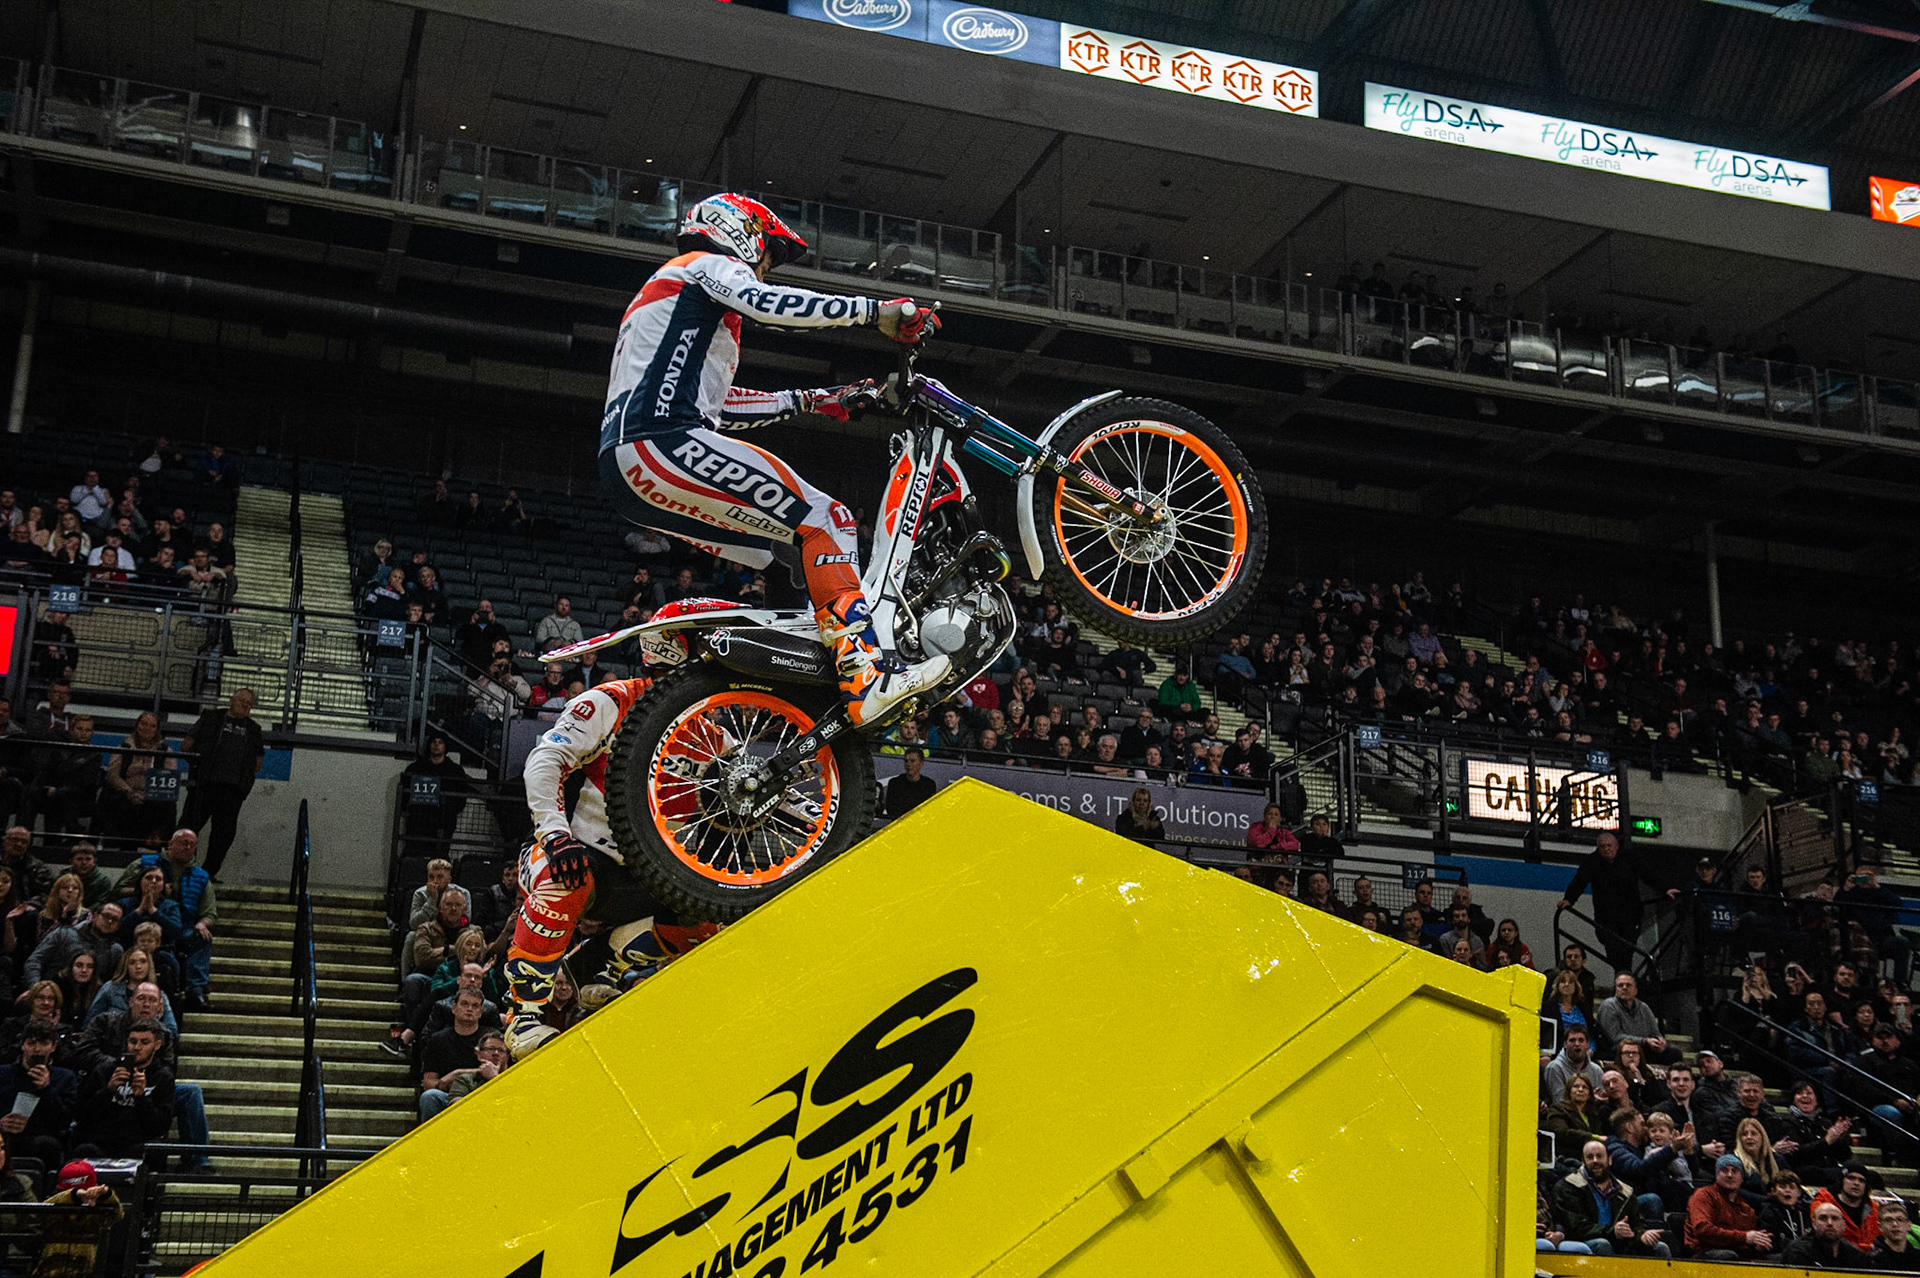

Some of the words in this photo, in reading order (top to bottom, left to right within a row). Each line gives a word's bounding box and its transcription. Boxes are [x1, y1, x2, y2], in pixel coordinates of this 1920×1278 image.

[951, 16, 1015, 41] Cadbury
[1068, 40, 1110, 64] KTR
[1120, 50, 1161, 74] KTR
[1171, 60, 1213, 84] KTR
[1223, 70, 1263, 93] KTR
[1273, 79, 1313, 103] KTR
[1424, 125, 1466, 144] arena
[1581, 152, 1622, 171] arena
[1733, 179, 1773, 197] arena
[694, 270, 732, 298] hebo
[737, 287, 859, 320] REPSOL
[654, 327, 700, 418] HONDA
[672, 438, 797, 519] REPSOL
[1082, 471, 1122, 500] SHOWA
[901, 470, 930, 538] REPSOL
[725, 505, 791, 538] hebo
[813, 550, 860, 568] heb
[52, 590, 77, 602] 218
[381, 625, 403, 636] 217
[771, 655, 818, 672] ShinDengen
[820, 720, 840, 737] NGK
[1361, 731, 1379, 741] 217
[1591, 756, 1608, 765] 216
[150, 776, 177, 788] 118
[413, 783, 438, 794] 117
[752, 793, 780, 818] GALFER
[1107, 795, 1129, 816] IT
[1157, 801, 1250, 830] olutions
[1406, 868, 1426, 880] 117
[1712, 911, 1731, 921] 116
[907, 1072, 973, 1147] LTD
[801, 1114, 973, 1276] 4531
